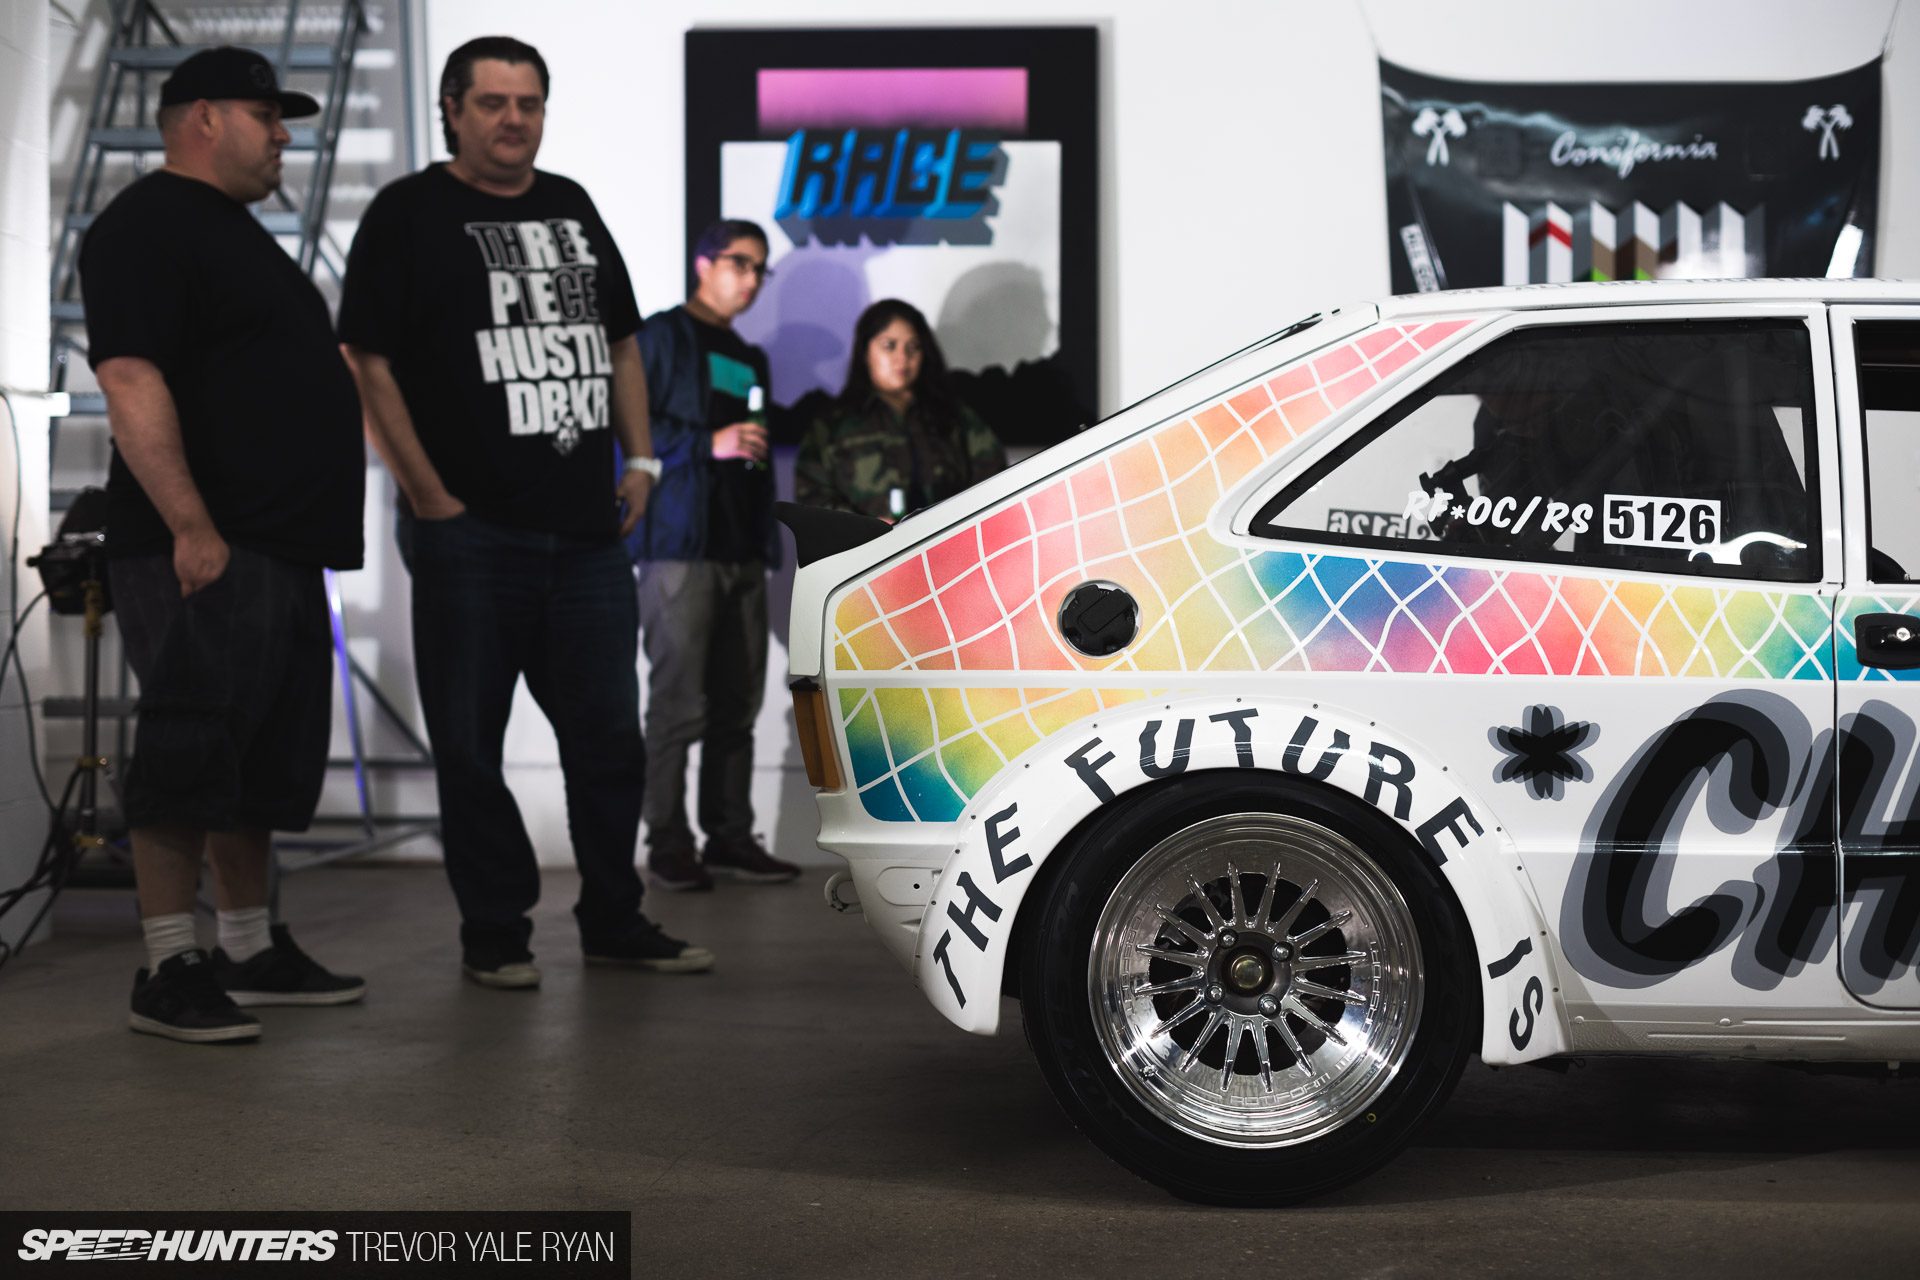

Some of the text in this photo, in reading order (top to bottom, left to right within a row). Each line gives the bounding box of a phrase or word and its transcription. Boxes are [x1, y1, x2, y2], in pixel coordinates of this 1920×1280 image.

[1551, 131, 1718, 180] Conifornia
[464, 218, 598, 270] THREE
[489, 267, 600, 326] PIECE
[1608, 499, 1716, 546] 5126
[932, 801, 1034, 1010] THE
[1063, 707, 1485, 869] FUTURE
[1486, 935, 1545, 1052] IS
